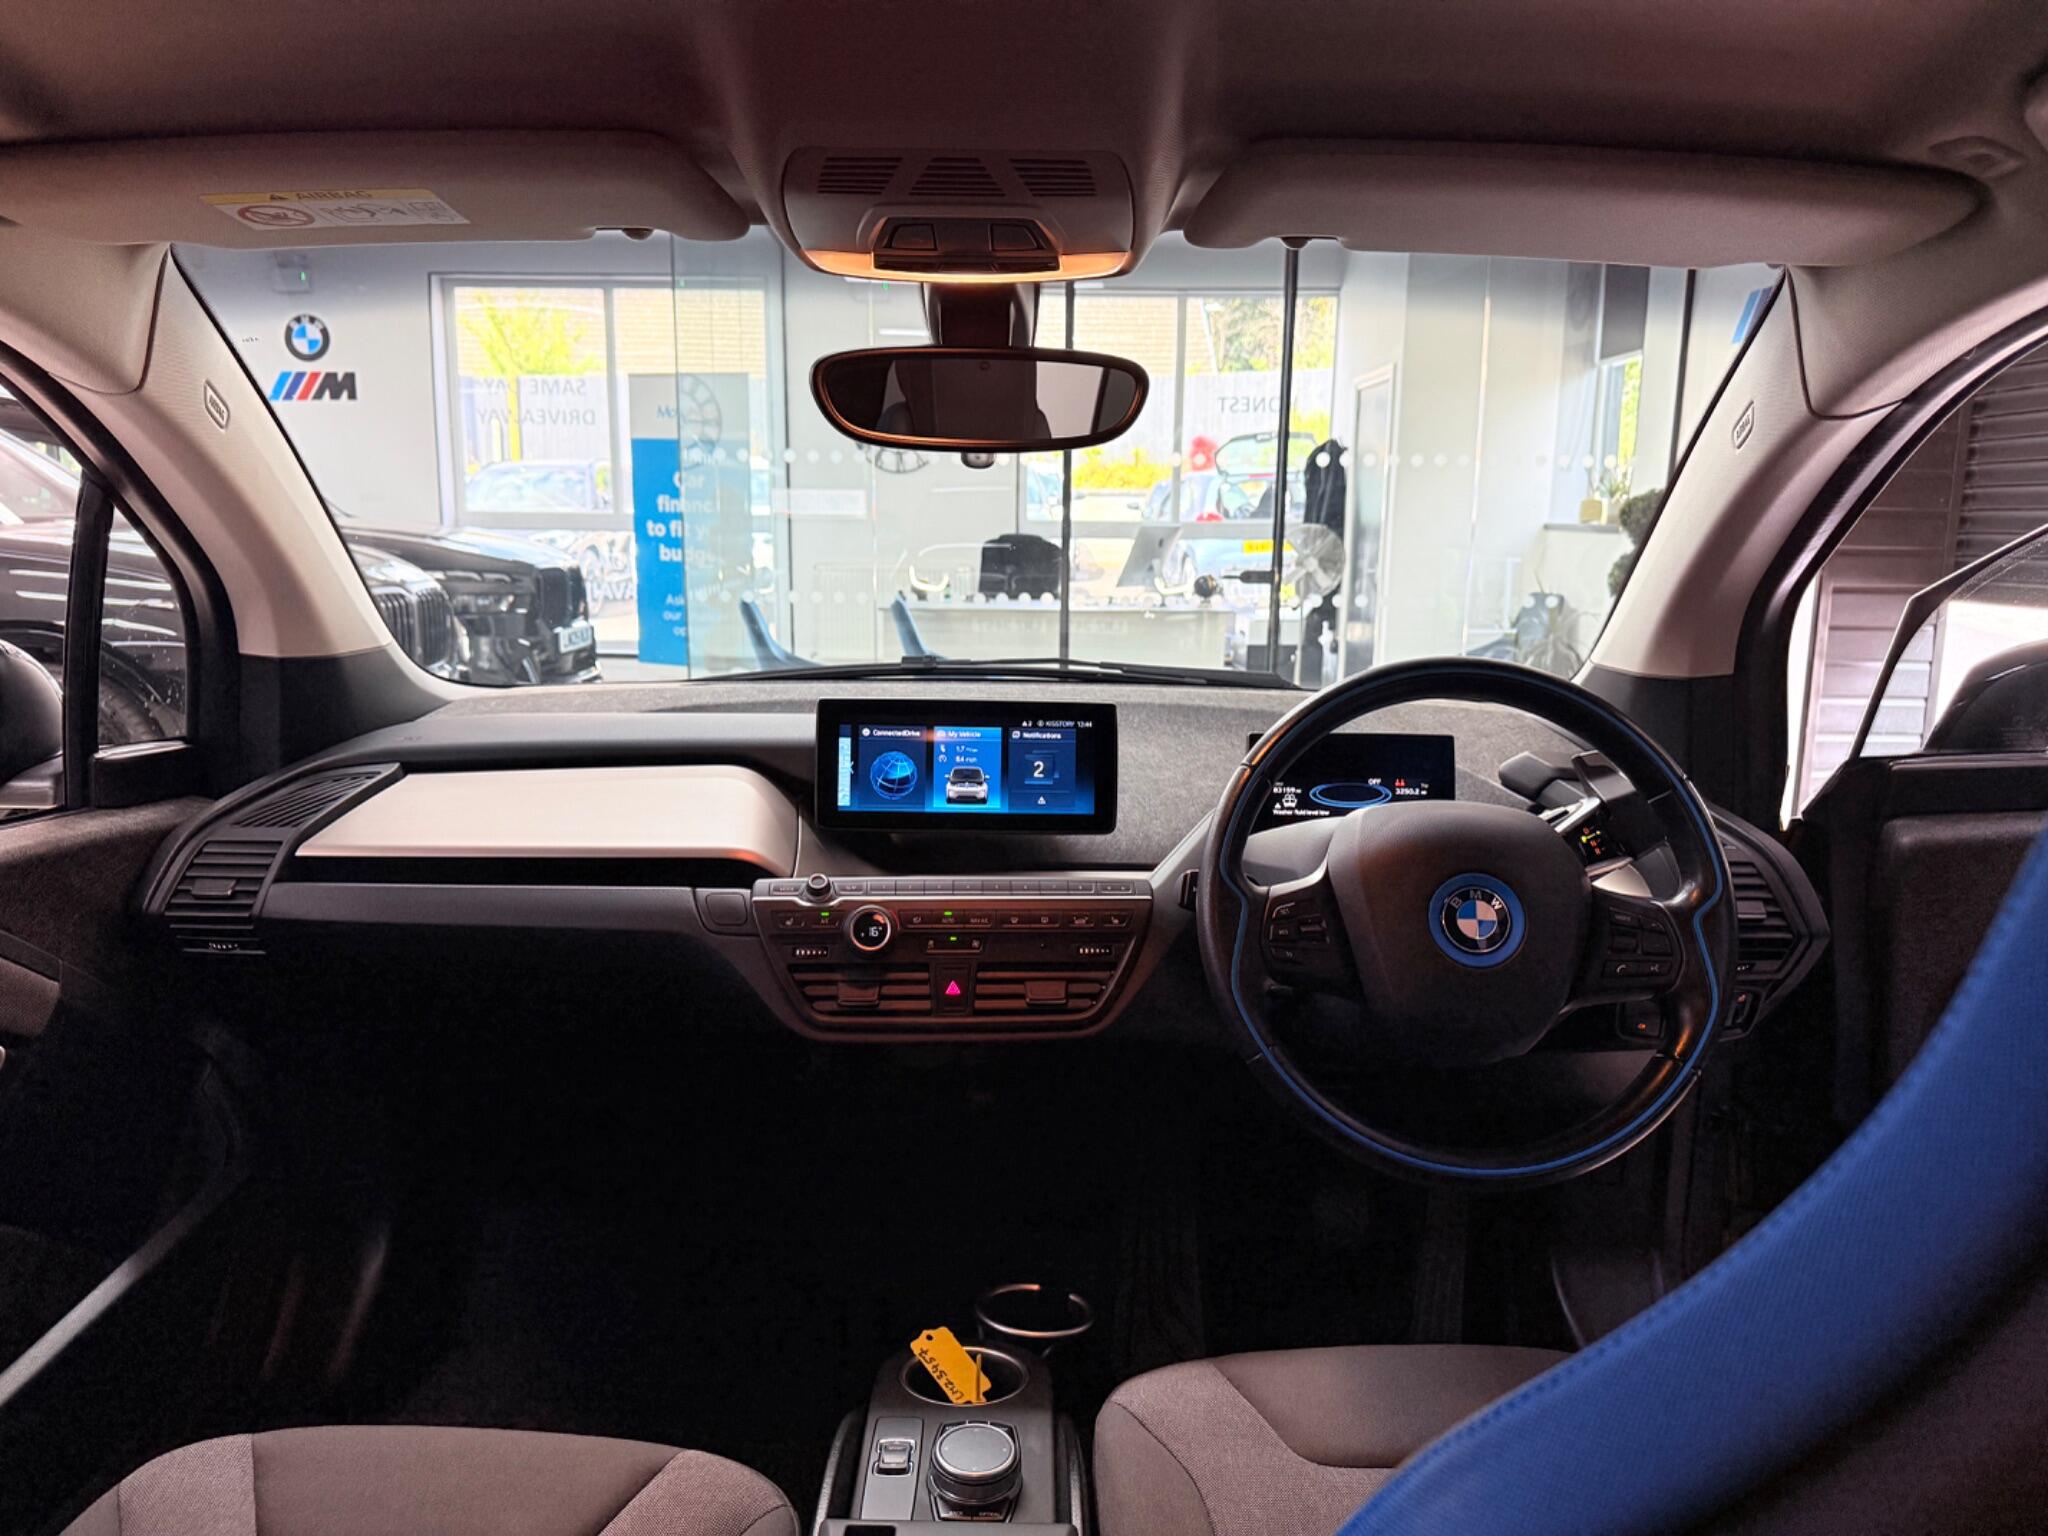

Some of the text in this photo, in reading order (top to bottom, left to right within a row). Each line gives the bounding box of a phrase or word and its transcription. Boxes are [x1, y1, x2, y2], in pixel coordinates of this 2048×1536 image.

[295, 190, 373, 201] AIRBAG
[657, 493, 720, 513] financ
[646, 519, 667, 538] to
[872, 729, 921, 737] ConnectedDrive
[1022, 731, 1062, 740] Notifications
[1032, 760, 1045, 778] 2
[1449, 887, 1504, 910] BMW
